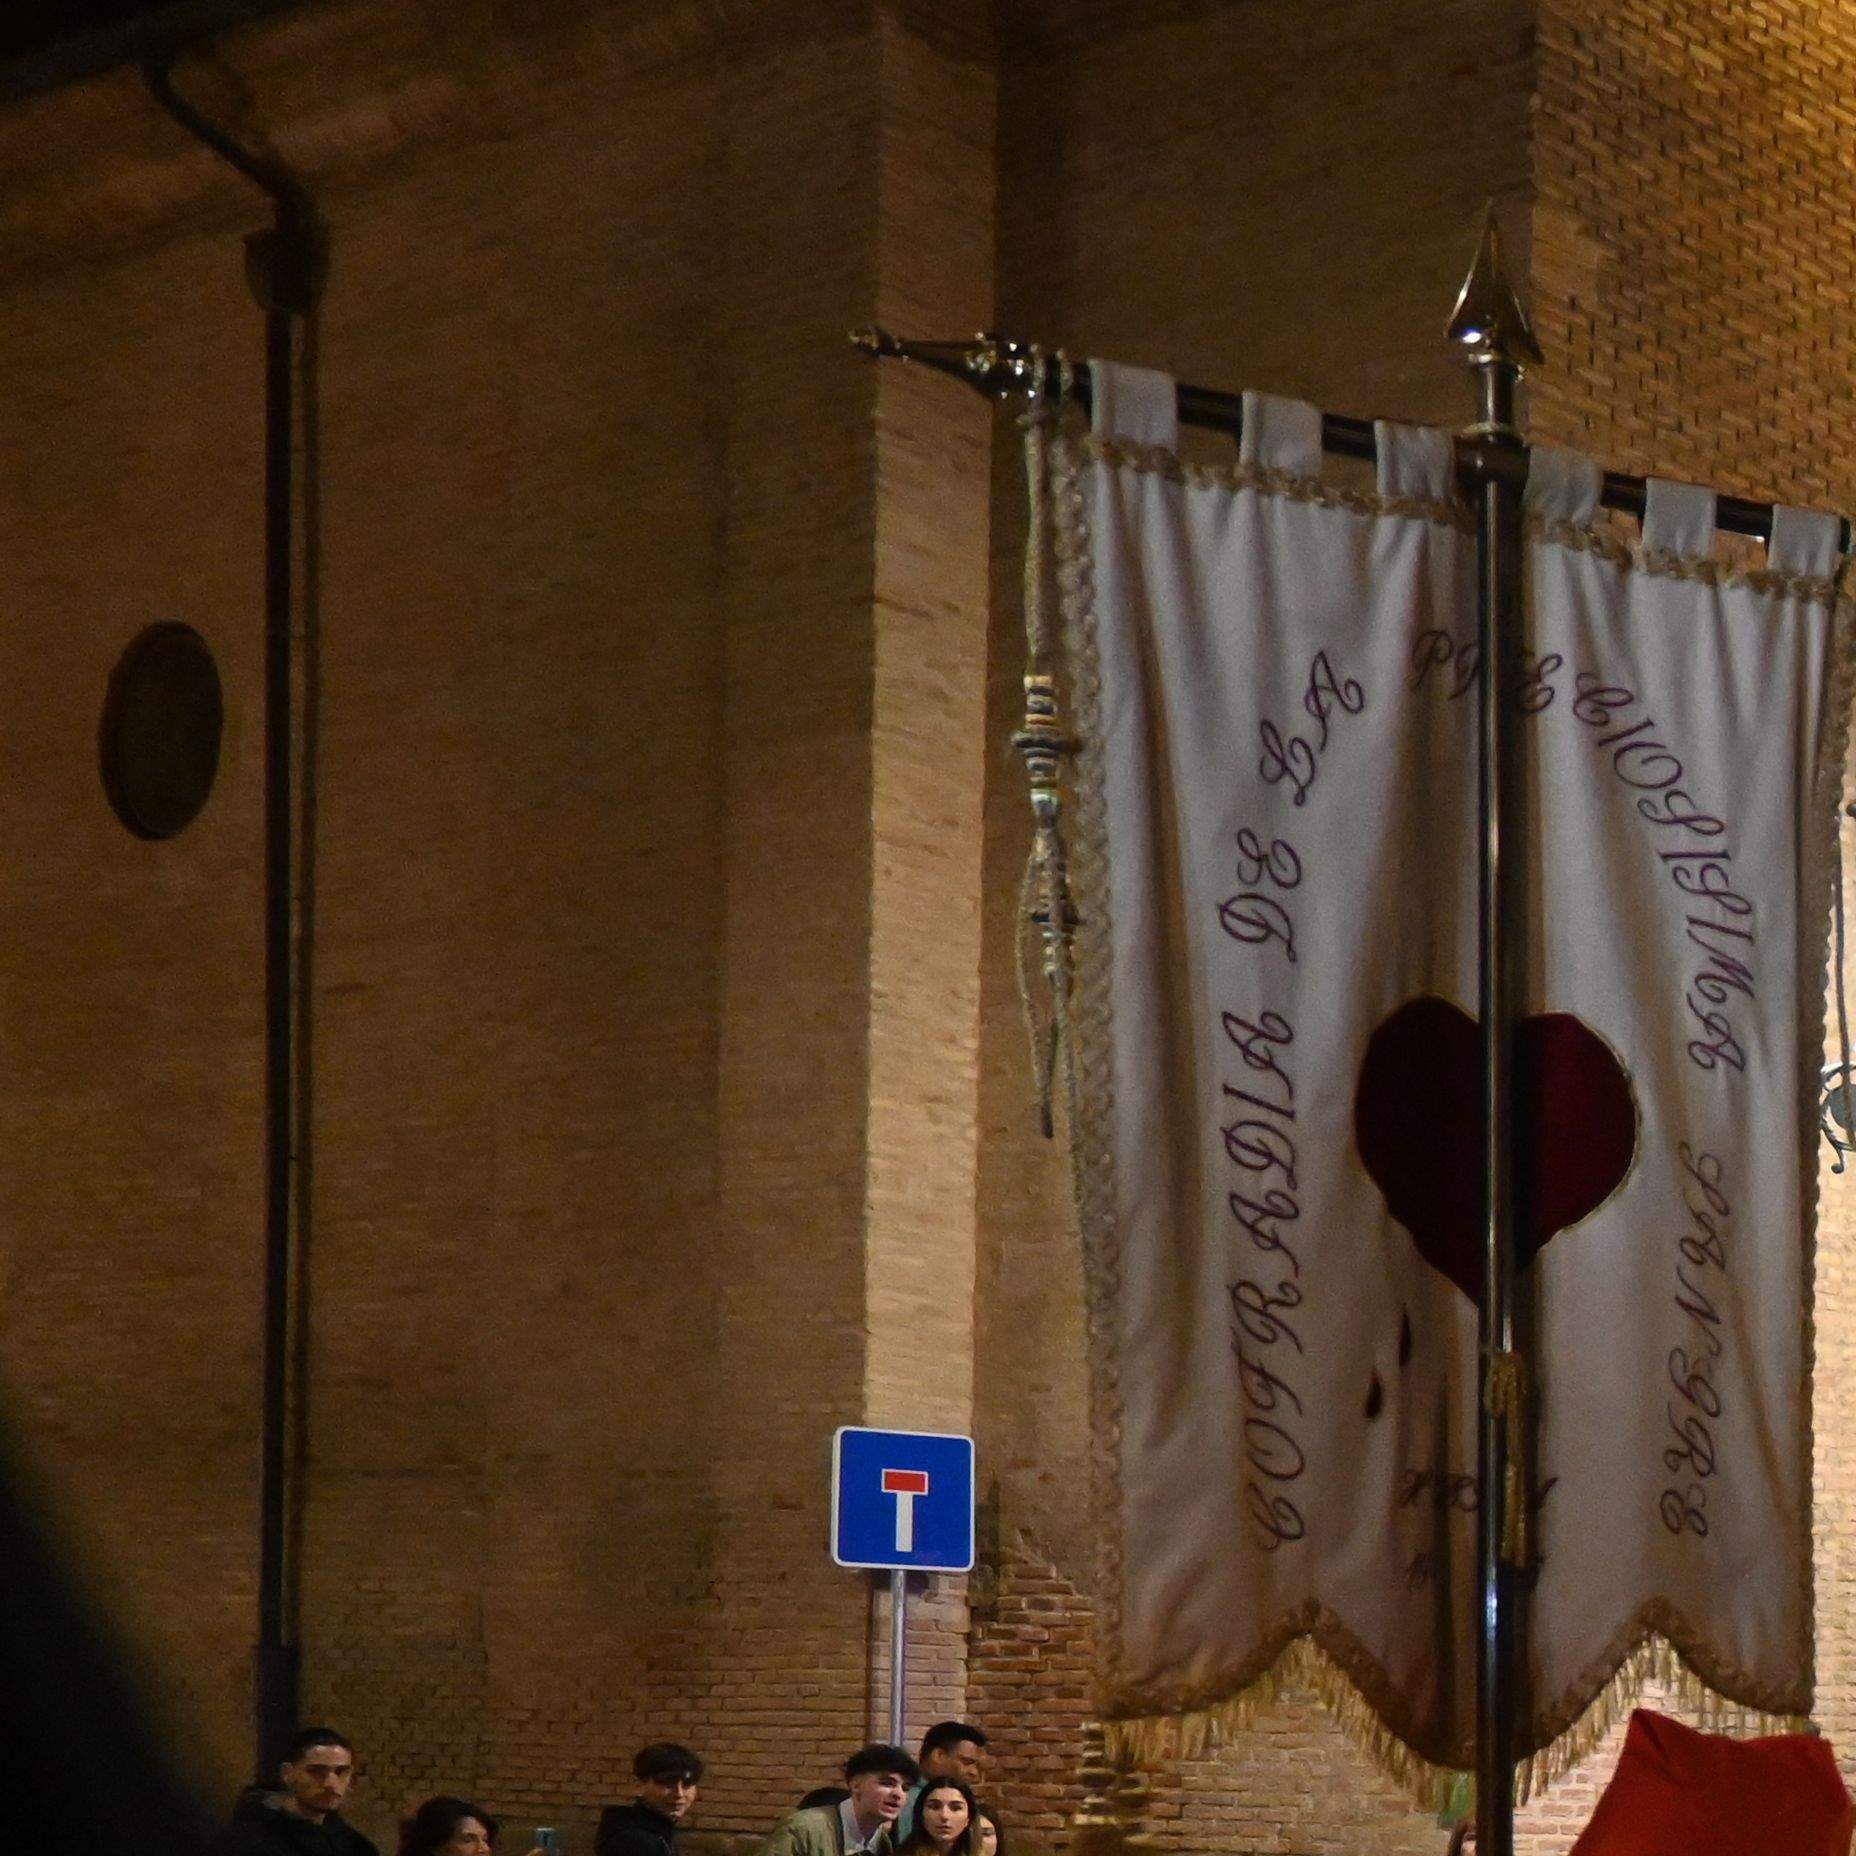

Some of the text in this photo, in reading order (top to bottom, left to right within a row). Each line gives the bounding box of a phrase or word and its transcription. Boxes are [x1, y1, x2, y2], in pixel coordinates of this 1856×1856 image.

[1259, 650, 1365, 807] LA
[1216, 827, 1302, 963] DE
[1219, 1010, 1305, 1552] COFRADIA
[1658, 1140, 1730, 1539] SANGRE
